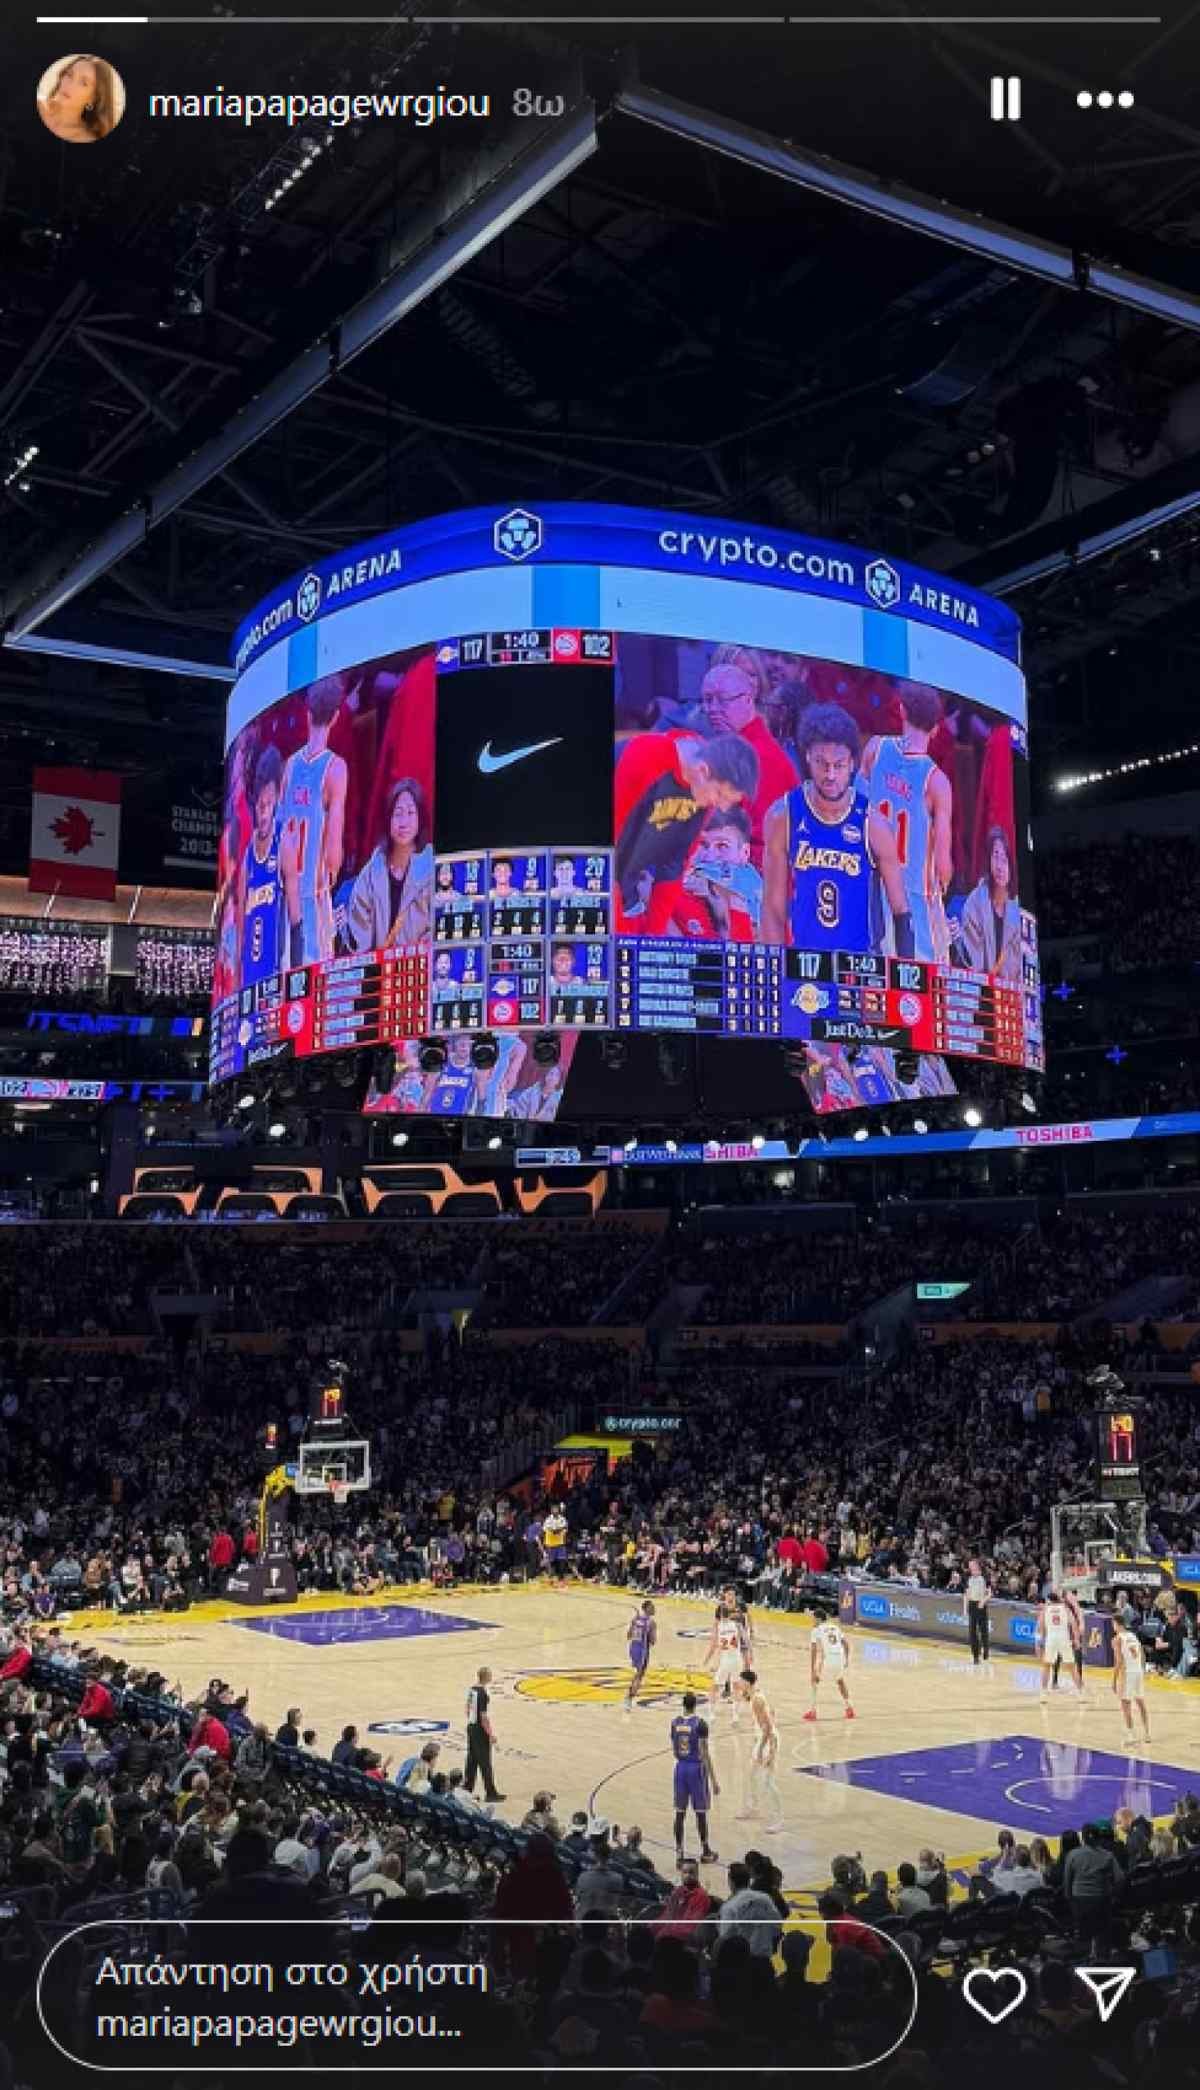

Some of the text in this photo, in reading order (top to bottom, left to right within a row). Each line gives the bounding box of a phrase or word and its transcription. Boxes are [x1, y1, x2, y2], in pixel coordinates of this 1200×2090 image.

[326, 548, 402, 599] ARENA
[659, 529, 980, 628] crypto.com ARENA
[503, 632, 540, 648] 1:40
[794, 839, 863, 877] LAKERS
[815, 880, 840, 929] 9
[797, 952, 822, 978] 117
[1016, 1125, 1093, 1144] TOSHIBA
